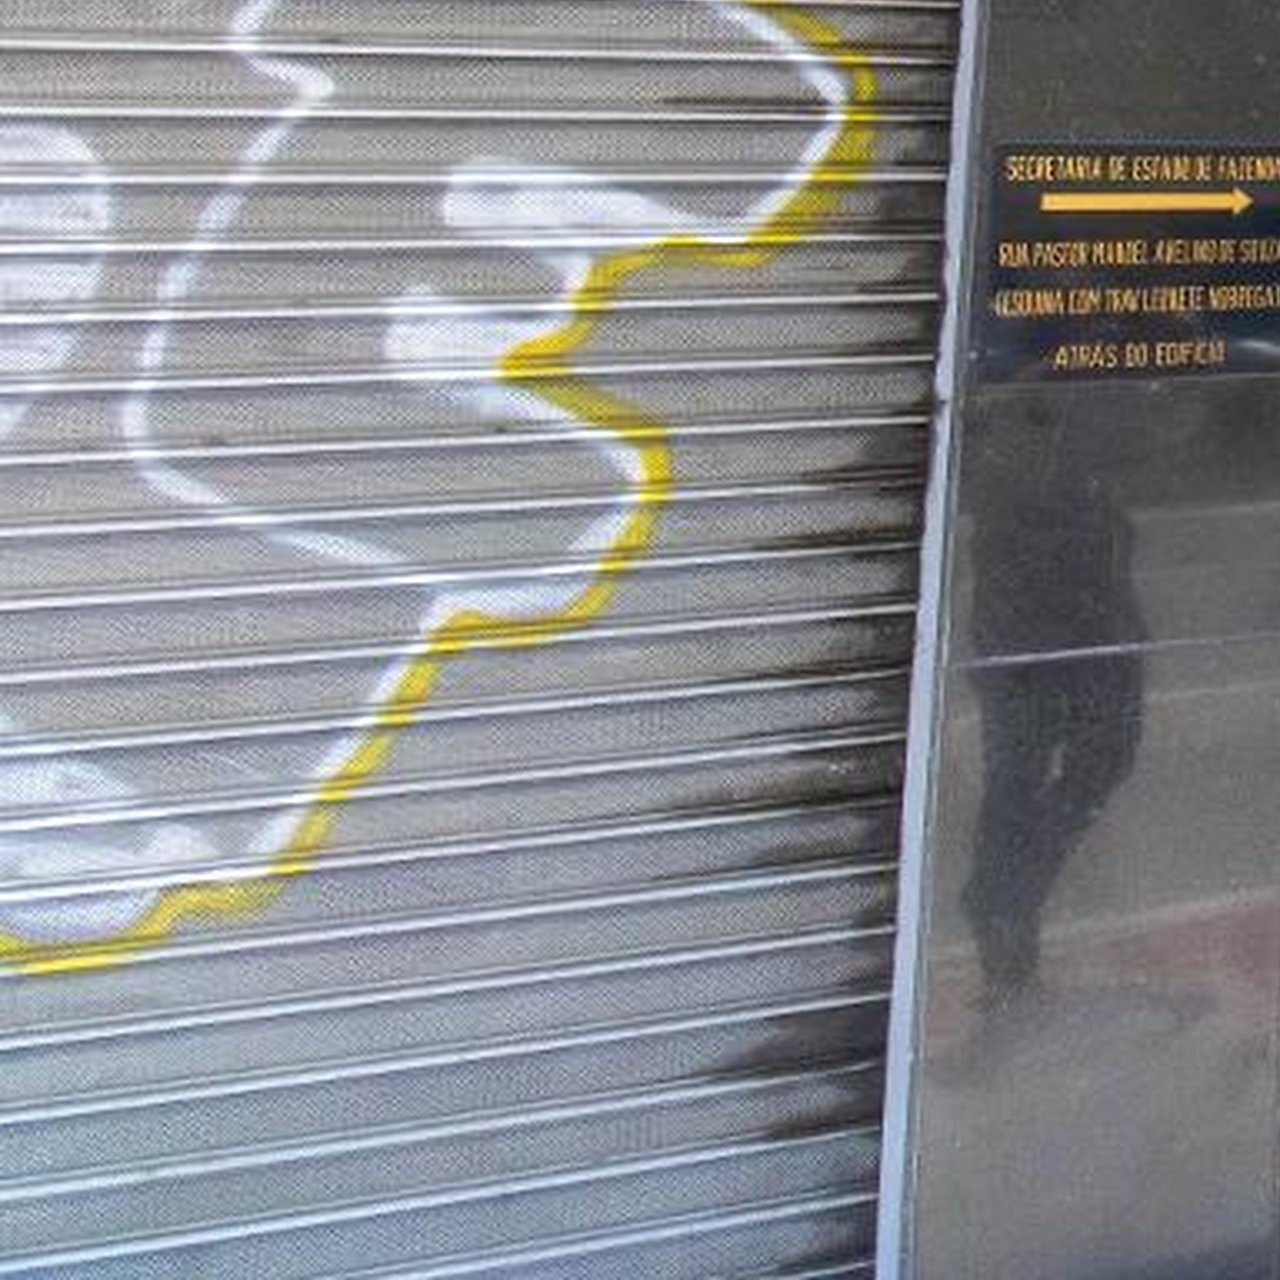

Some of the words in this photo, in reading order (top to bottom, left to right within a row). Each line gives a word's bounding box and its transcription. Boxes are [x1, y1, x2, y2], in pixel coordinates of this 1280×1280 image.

[1006, 155, 1101, 181] SECRETARIA
[1108, 156, 1127, 180] DE
[1132, 155, 1189, 180] ESTADO
[999, 241, 1030, 267] RUA
[1033, 241, 1089, 267] PASTOR
[1068, 286, 1100, 316] COM
[1125, 342, 1149, 368] DO
